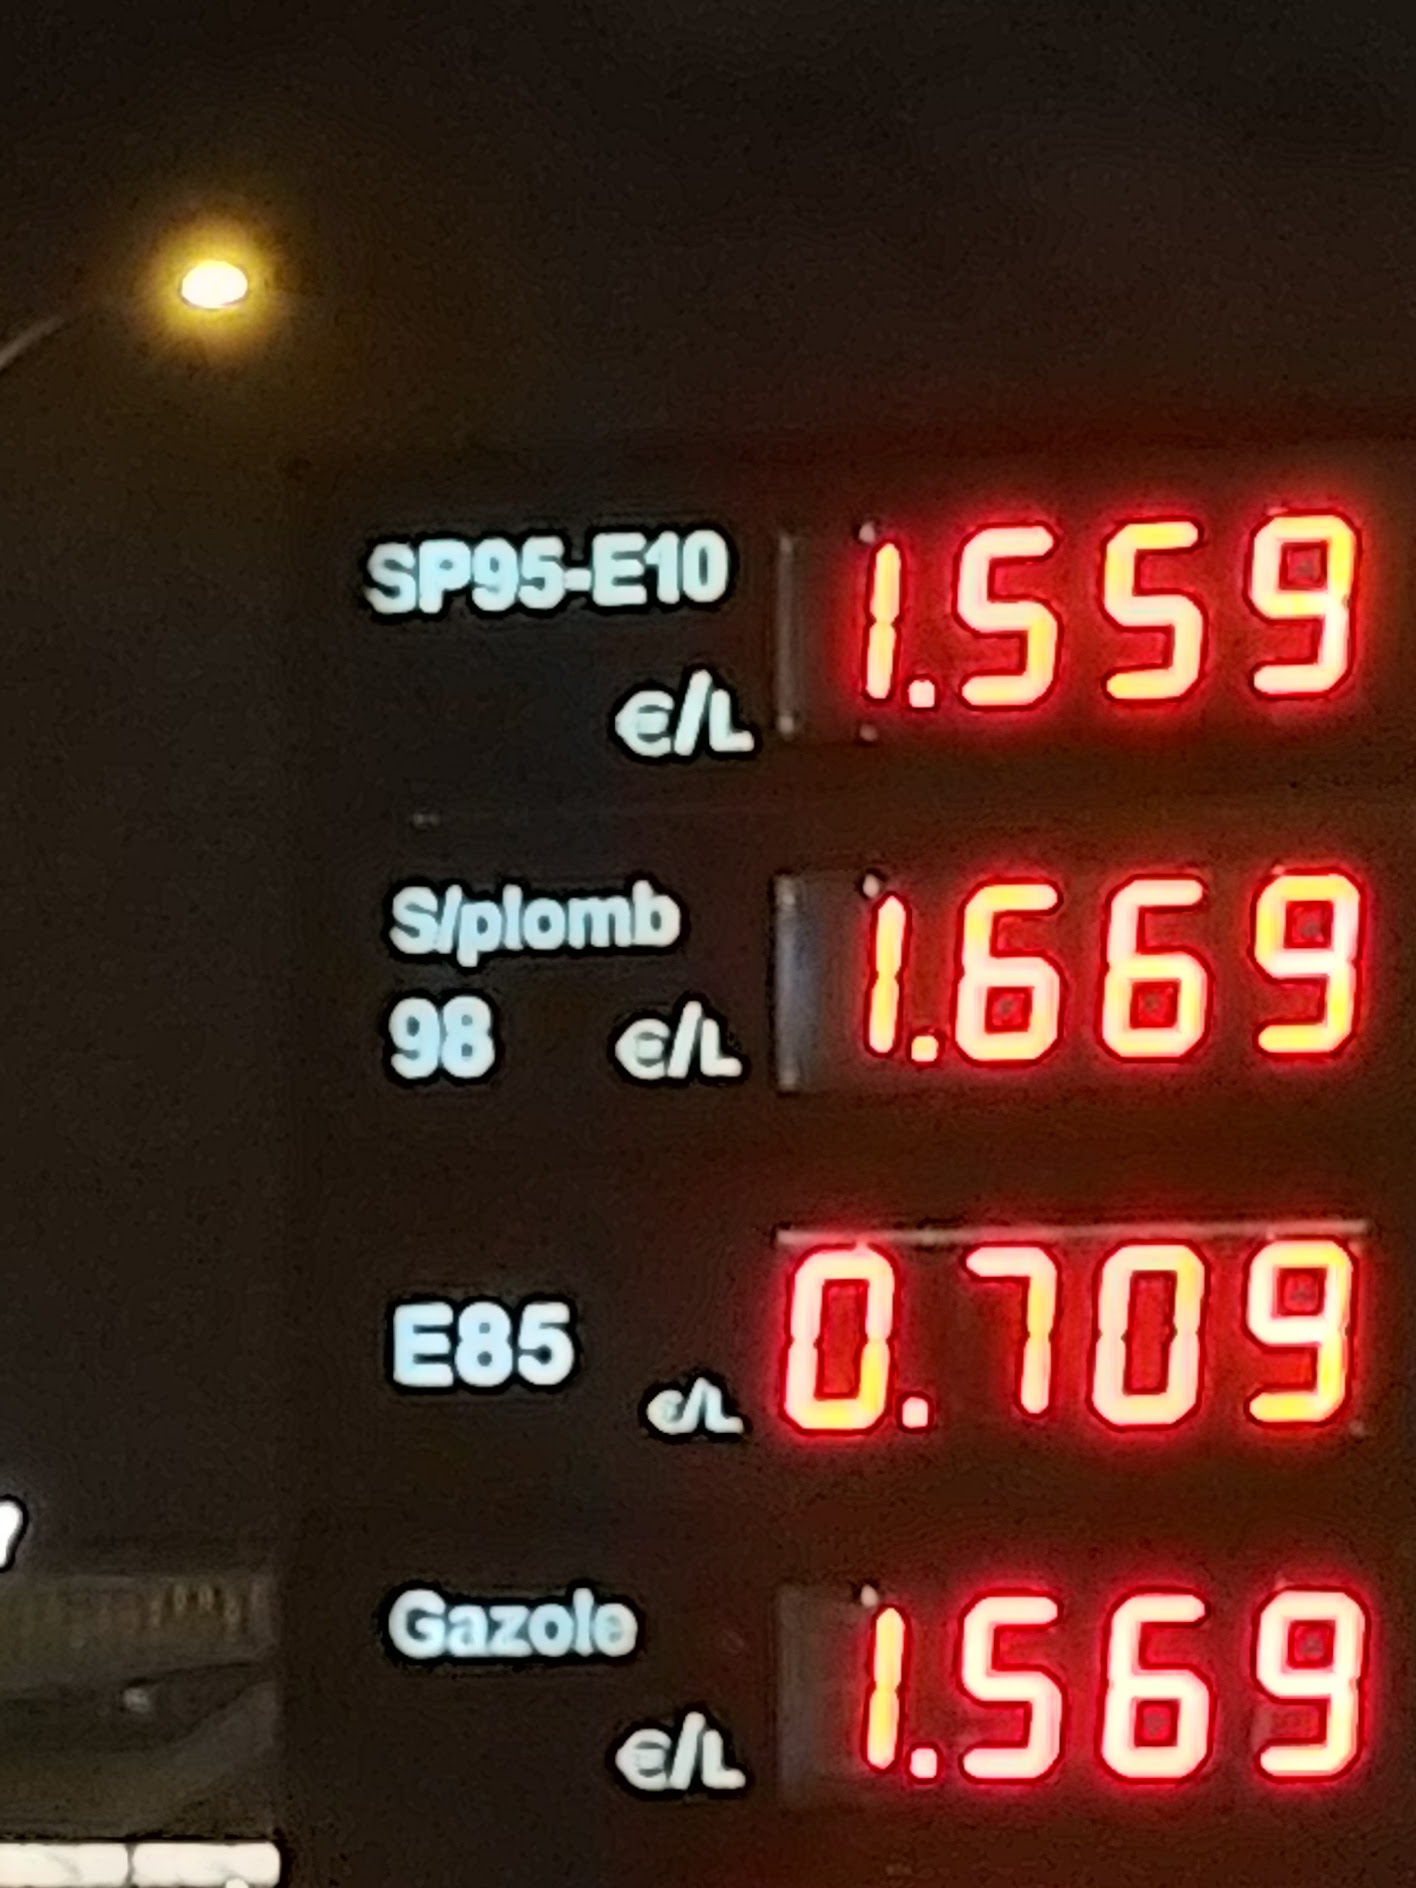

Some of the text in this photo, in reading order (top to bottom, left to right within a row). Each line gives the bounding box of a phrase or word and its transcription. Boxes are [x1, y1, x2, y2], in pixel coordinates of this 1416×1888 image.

[367, 512, 1359, 710] SP95-E10 1.559
[613, 668, 756, 758] €/L
[388, 994, 743, 1081] 98 €/L
[389, 871, 1364, 1064] S/plomb 1.669
[392, 1242, 1357, 1432] E85 0.709
[645, 1376, 744, 1436] €/L
[387, 1587, 1369, 1781] Gazole 1.569
[614, 1711, 747, 1791] €/L
